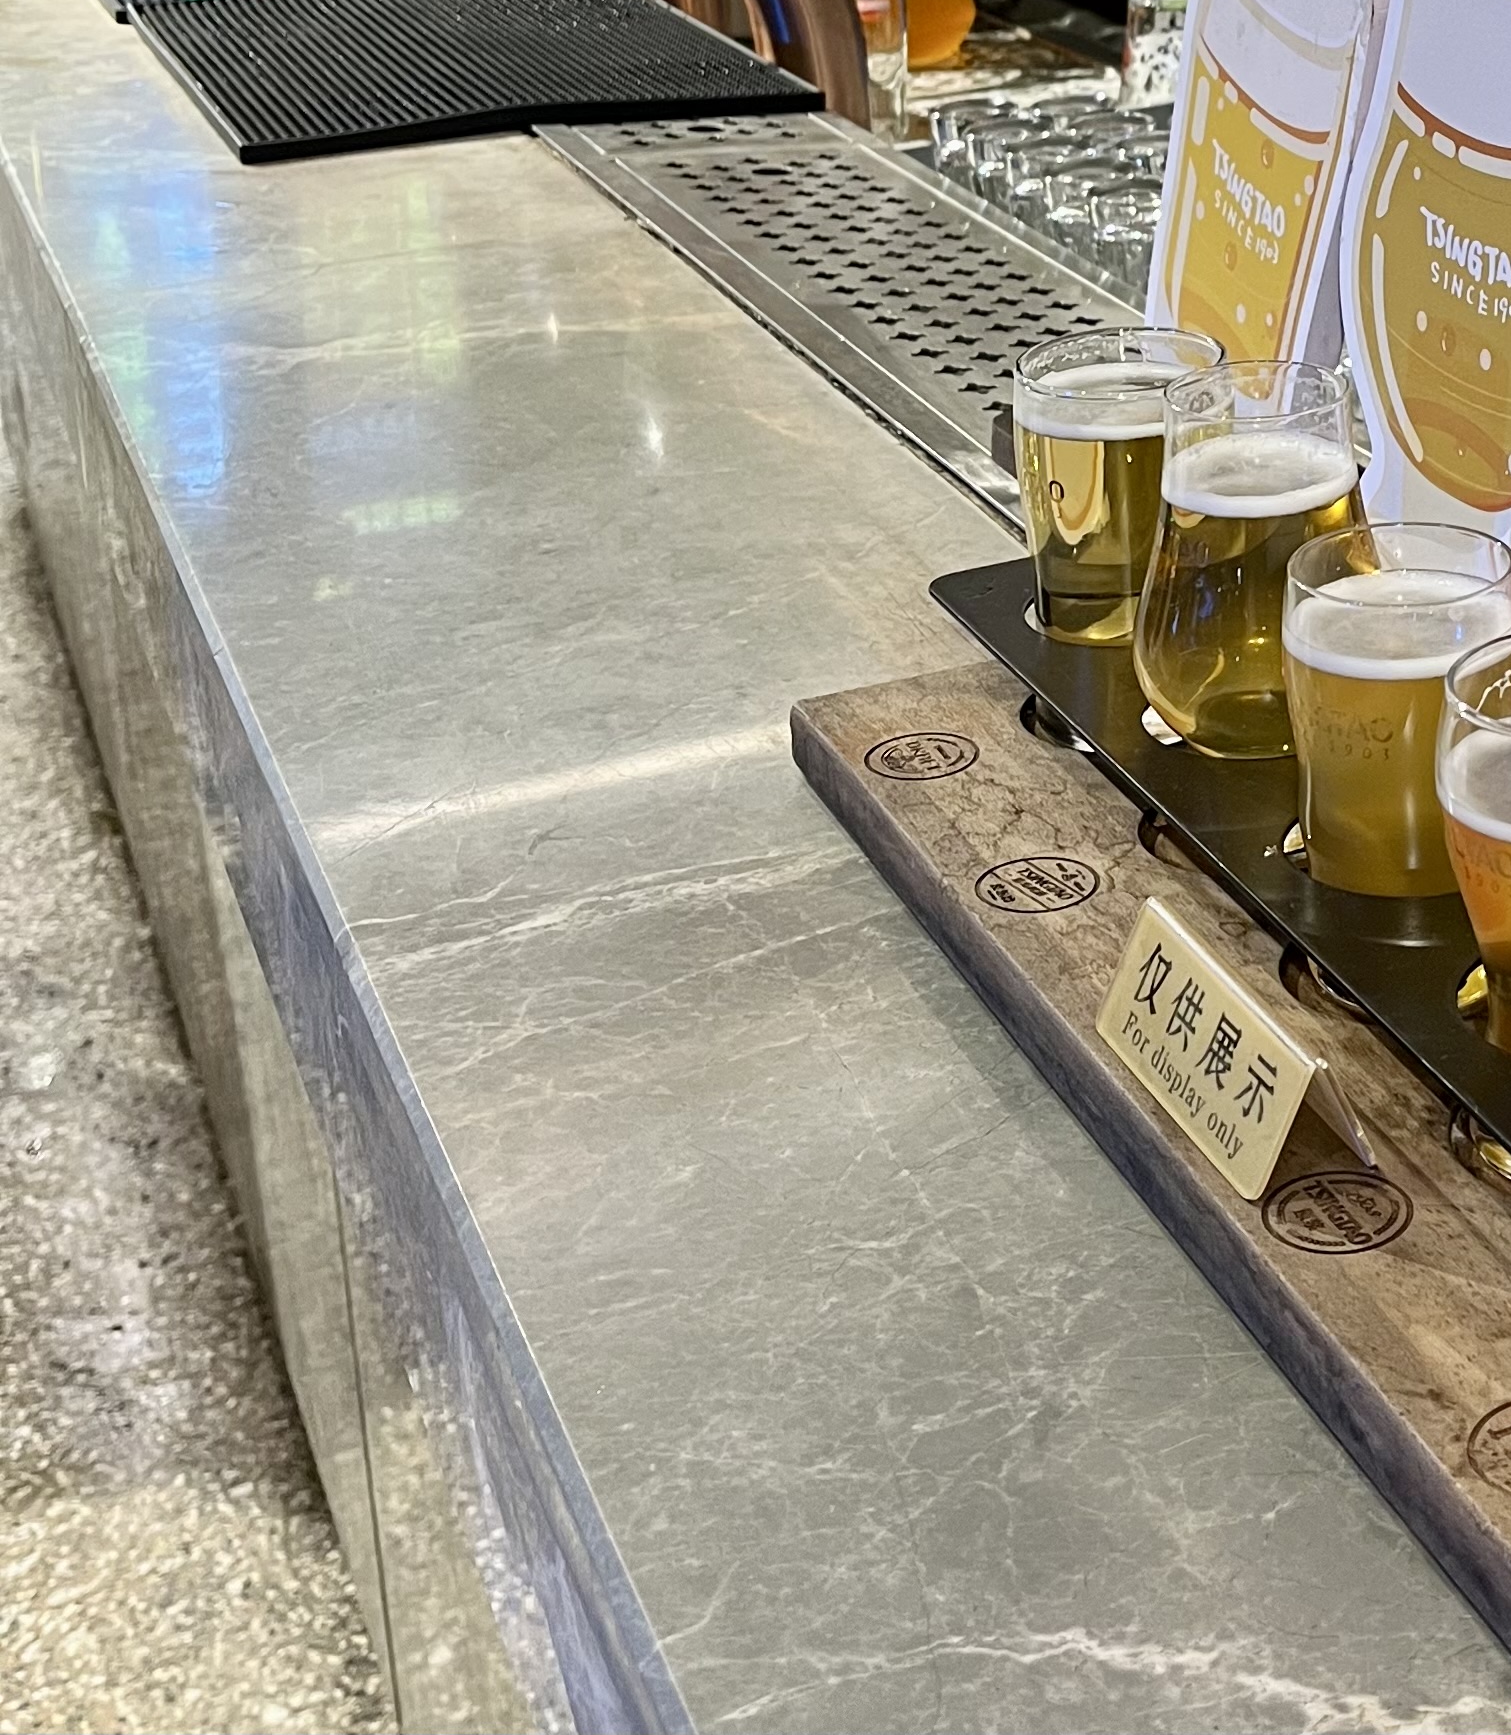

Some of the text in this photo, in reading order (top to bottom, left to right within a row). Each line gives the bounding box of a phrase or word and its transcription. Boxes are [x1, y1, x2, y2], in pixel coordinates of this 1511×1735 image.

[1212, 138, 1286, 238] TSINGTAO
[1214, 188, 1280, 265] SINCE 1903
[1431, 261, 1489, 316] SINCE
[1133, 942, 1278, 1125] 仅供展示
[1121, 1010, 1244, 1160] For display only
[1302, 1178, 1374, 1246] TSINGTAO
